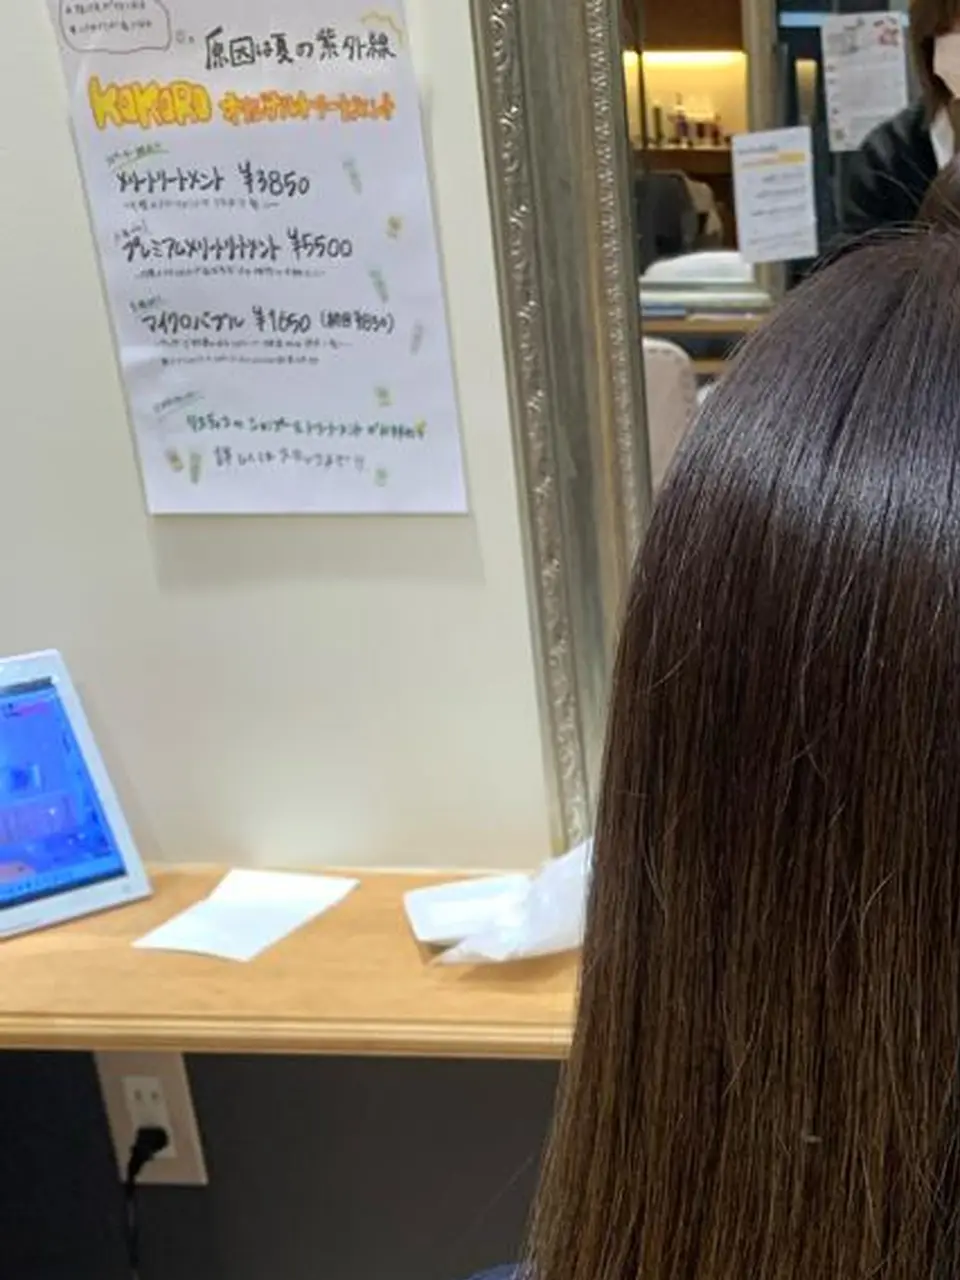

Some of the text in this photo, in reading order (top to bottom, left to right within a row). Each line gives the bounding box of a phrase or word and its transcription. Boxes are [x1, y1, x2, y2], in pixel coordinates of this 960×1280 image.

[205, 25, 396, 69] 原因は夏の紫外線
[141, 310, 245, 334] マイクロバブル
